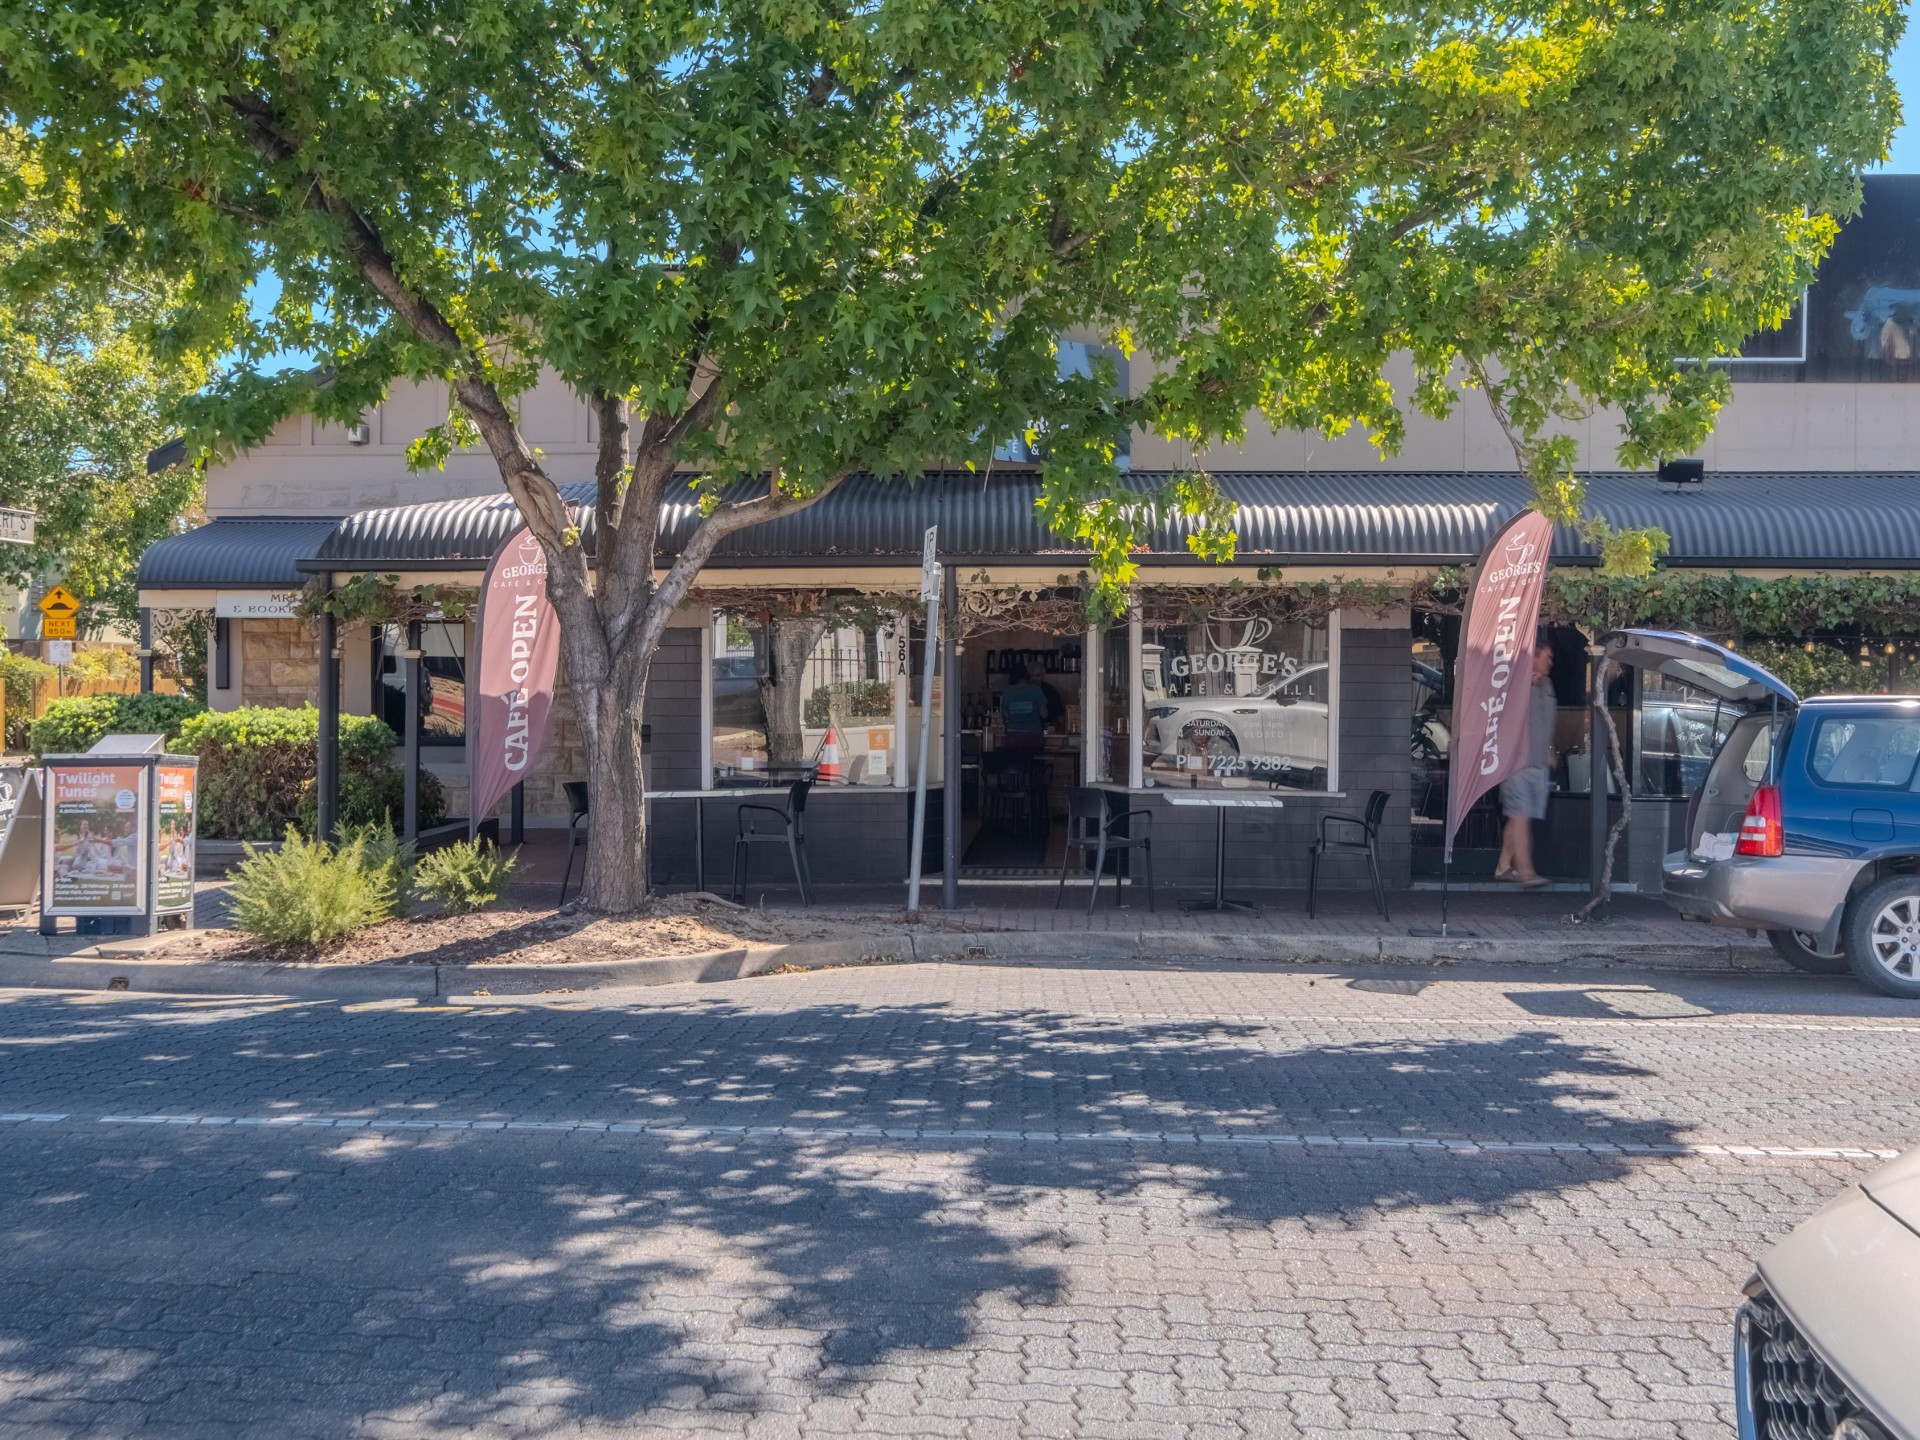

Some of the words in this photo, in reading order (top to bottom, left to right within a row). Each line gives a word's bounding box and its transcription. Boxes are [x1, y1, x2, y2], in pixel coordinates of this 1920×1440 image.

[1490, 560, 1541, 583] GEORGE'S
[48, 620, 71, 628] NEXT
[510, 594, 538, 684] OPEN
[1491, 596, 1521, 689] OPEN
[1171, 651, 1298, 677] GEORGE'S
[1223, 683, 1234, 695] &
[501, 687, 529, 772] CAFÉ
[1243, 731, 1284, 739] CLOSED
[1480, 691, 1507, 776] CAFÉ
[1207, 755, 1247, 770] 7225
[1252, 756, 1292, 771] 9382
[58, 771, 116, 786] Twilight
[159, 772, 185, 787] Twilight
[58, 786, 98, 798] Tunes
